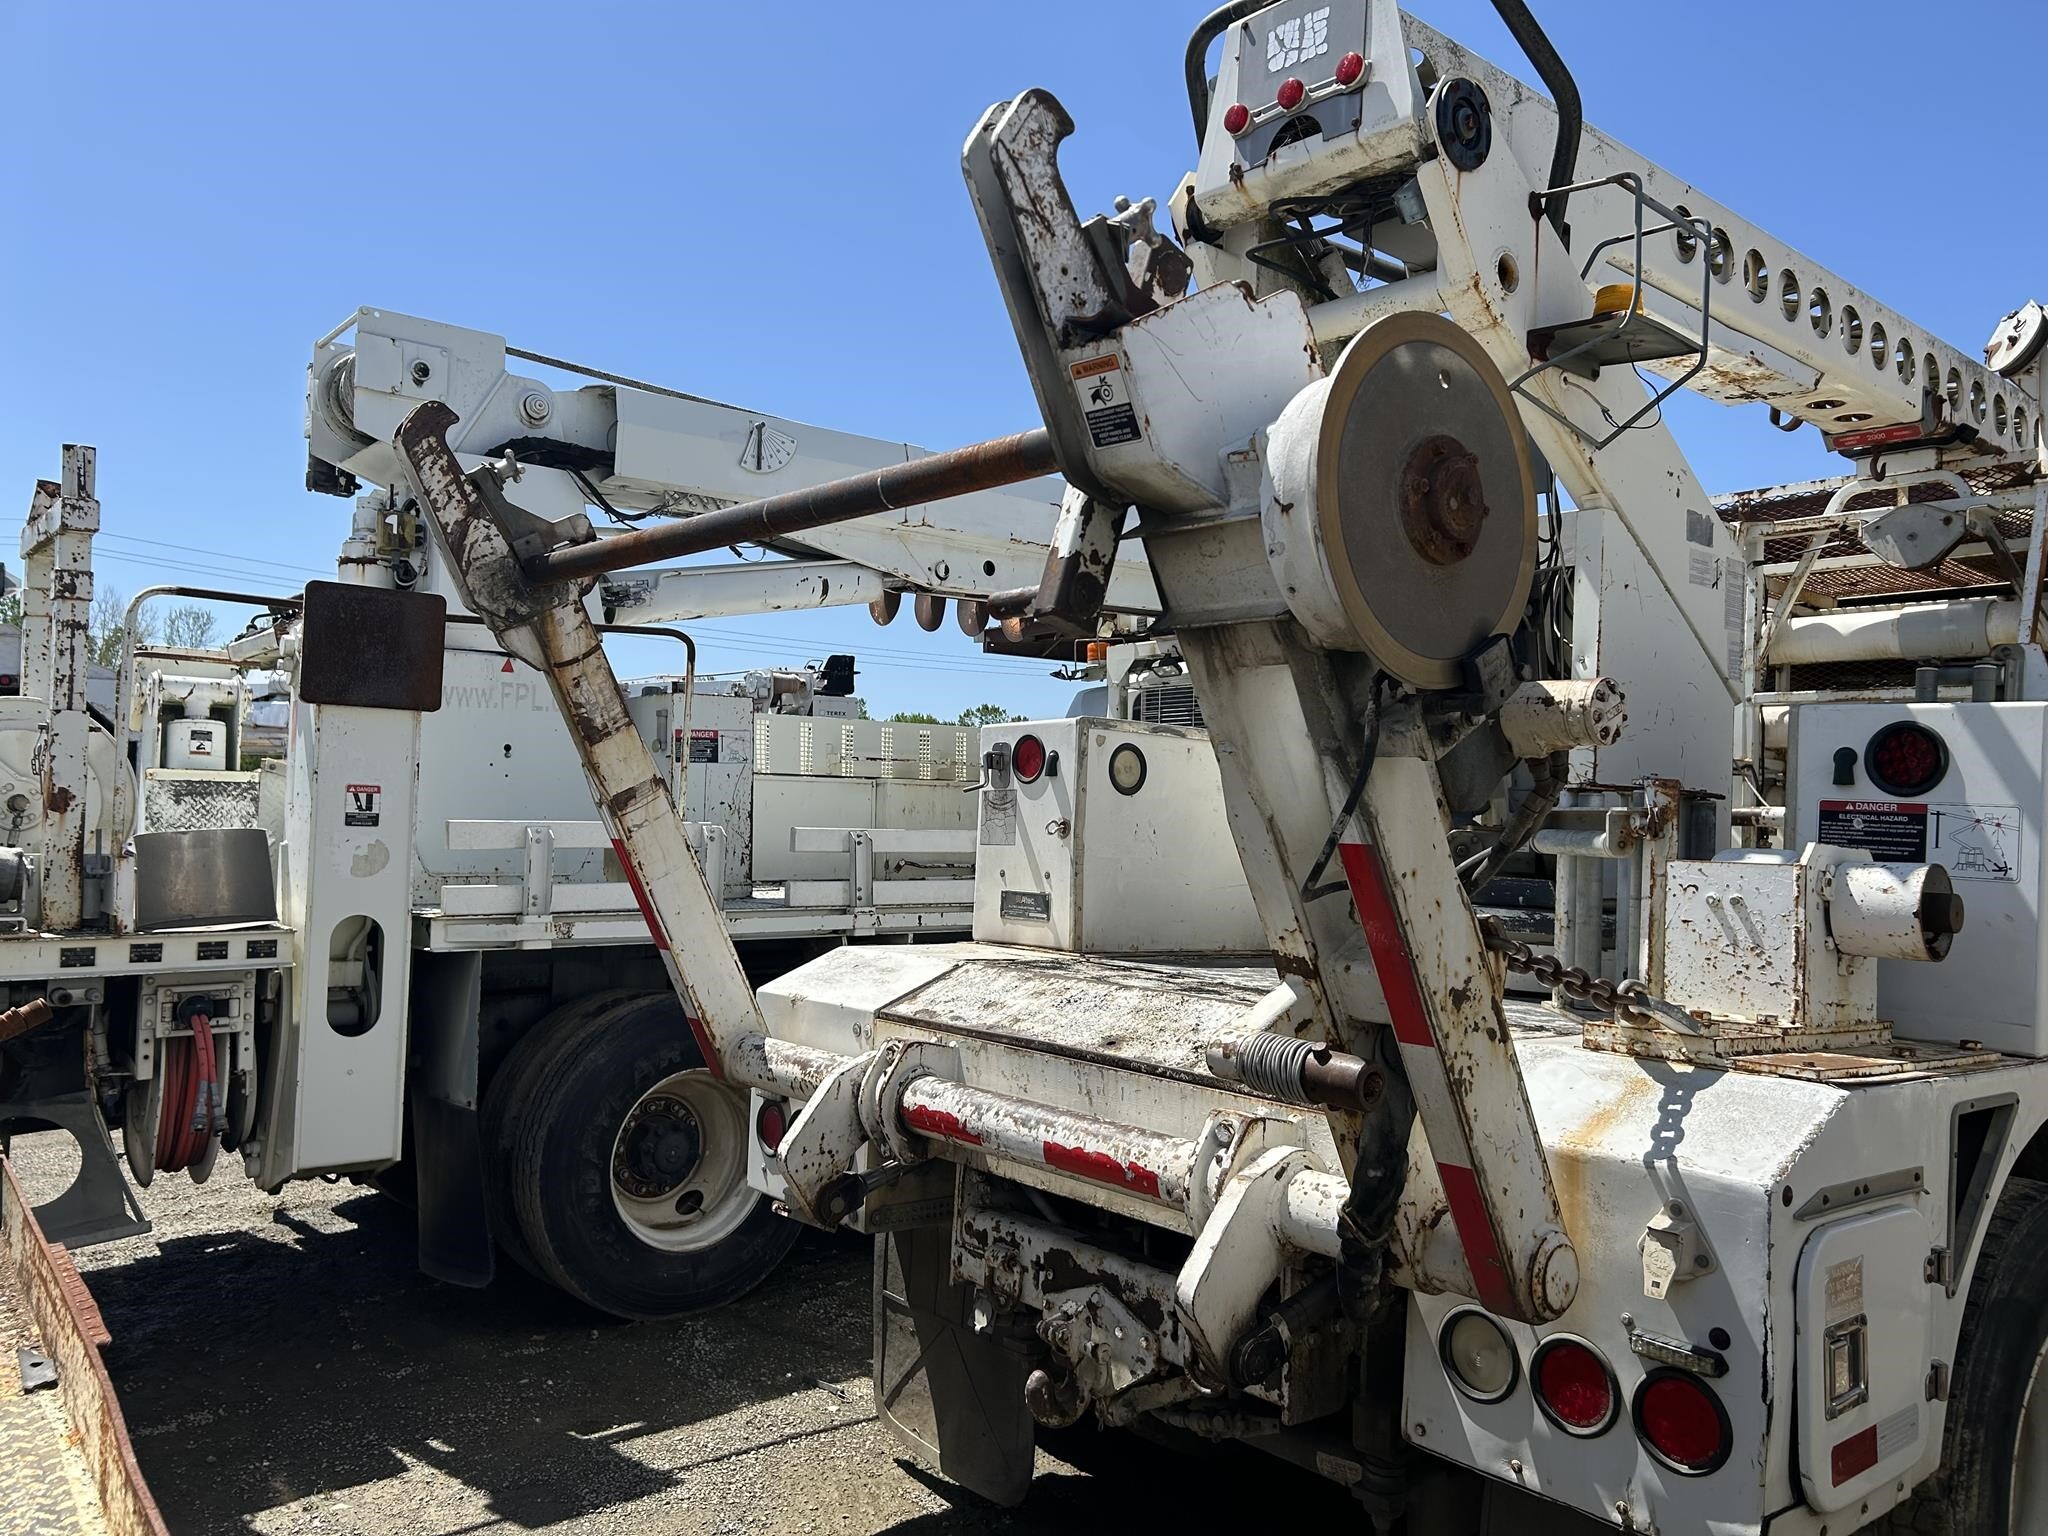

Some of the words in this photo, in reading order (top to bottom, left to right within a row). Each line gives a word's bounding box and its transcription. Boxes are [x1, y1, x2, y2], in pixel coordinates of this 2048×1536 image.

[1083, 358, 1114, 371] WARNING
[1866, 432, 1886, 441] 2000
[1855, 802, 1898, 812] DANGER
[1838, 813, 1879, 821] ELECTRICAL
